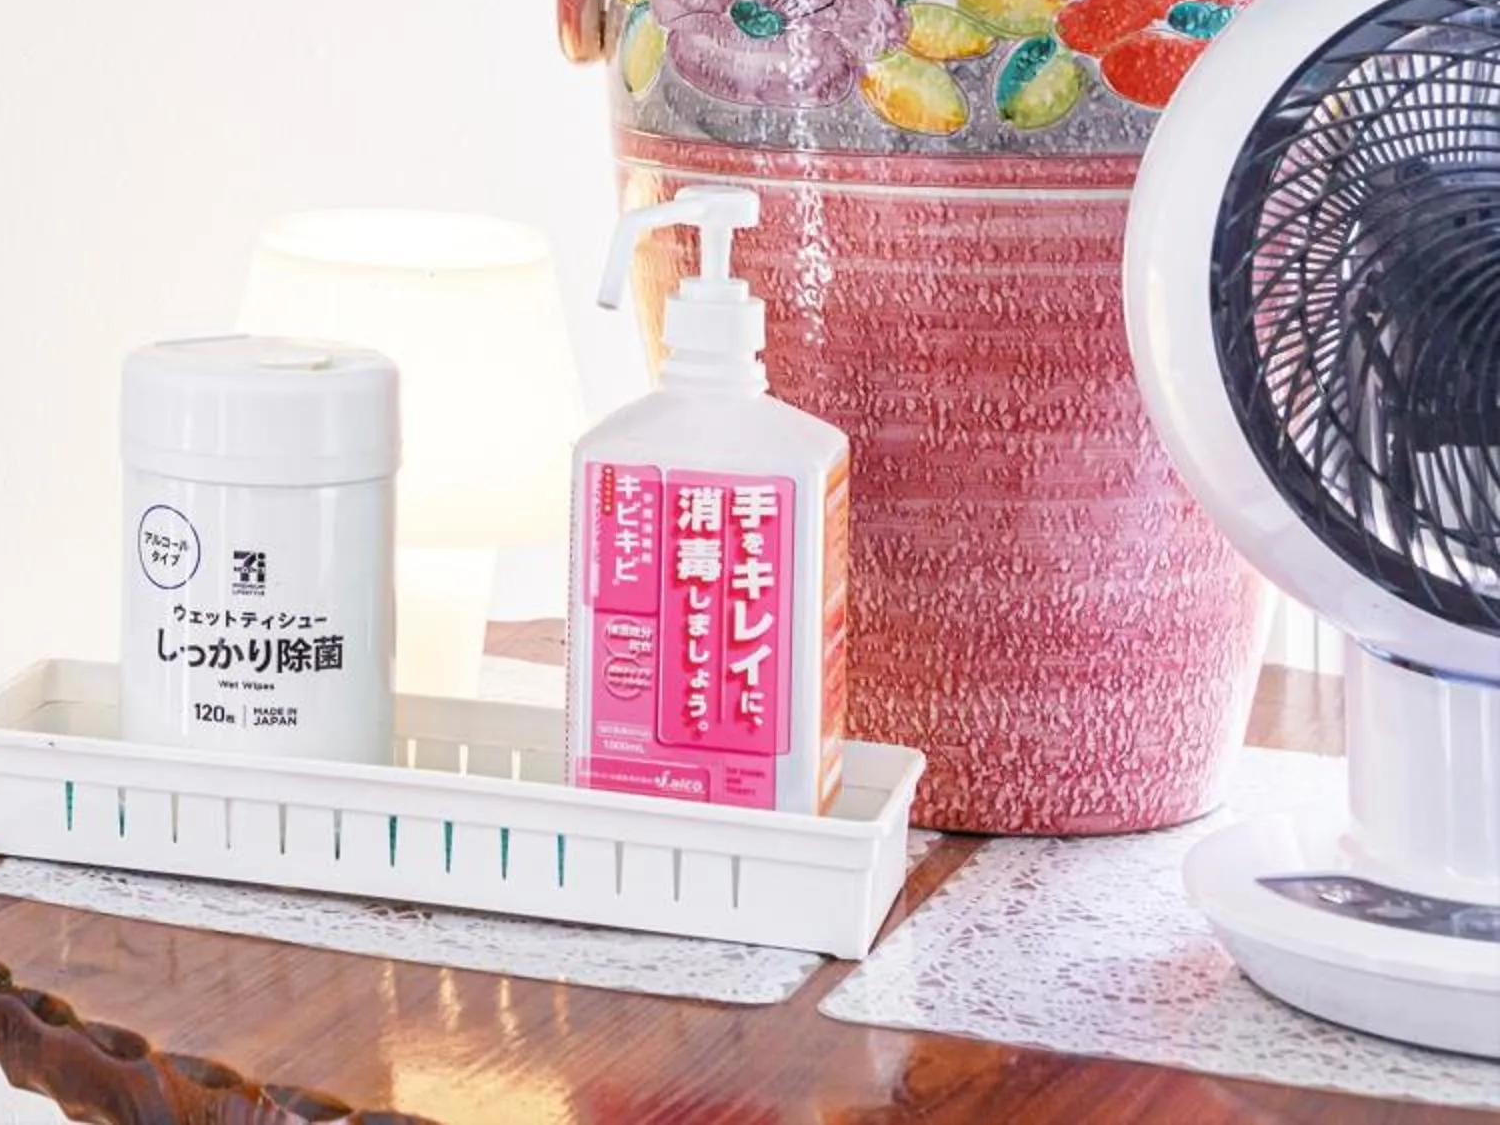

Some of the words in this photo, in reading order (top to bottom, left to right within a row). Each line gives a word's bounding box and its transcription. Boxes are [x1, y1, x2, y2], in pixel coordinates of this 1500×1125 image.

[158, 628, 344, 673] しっかり除菌
[253, 716, 297, 726] JAPAN
